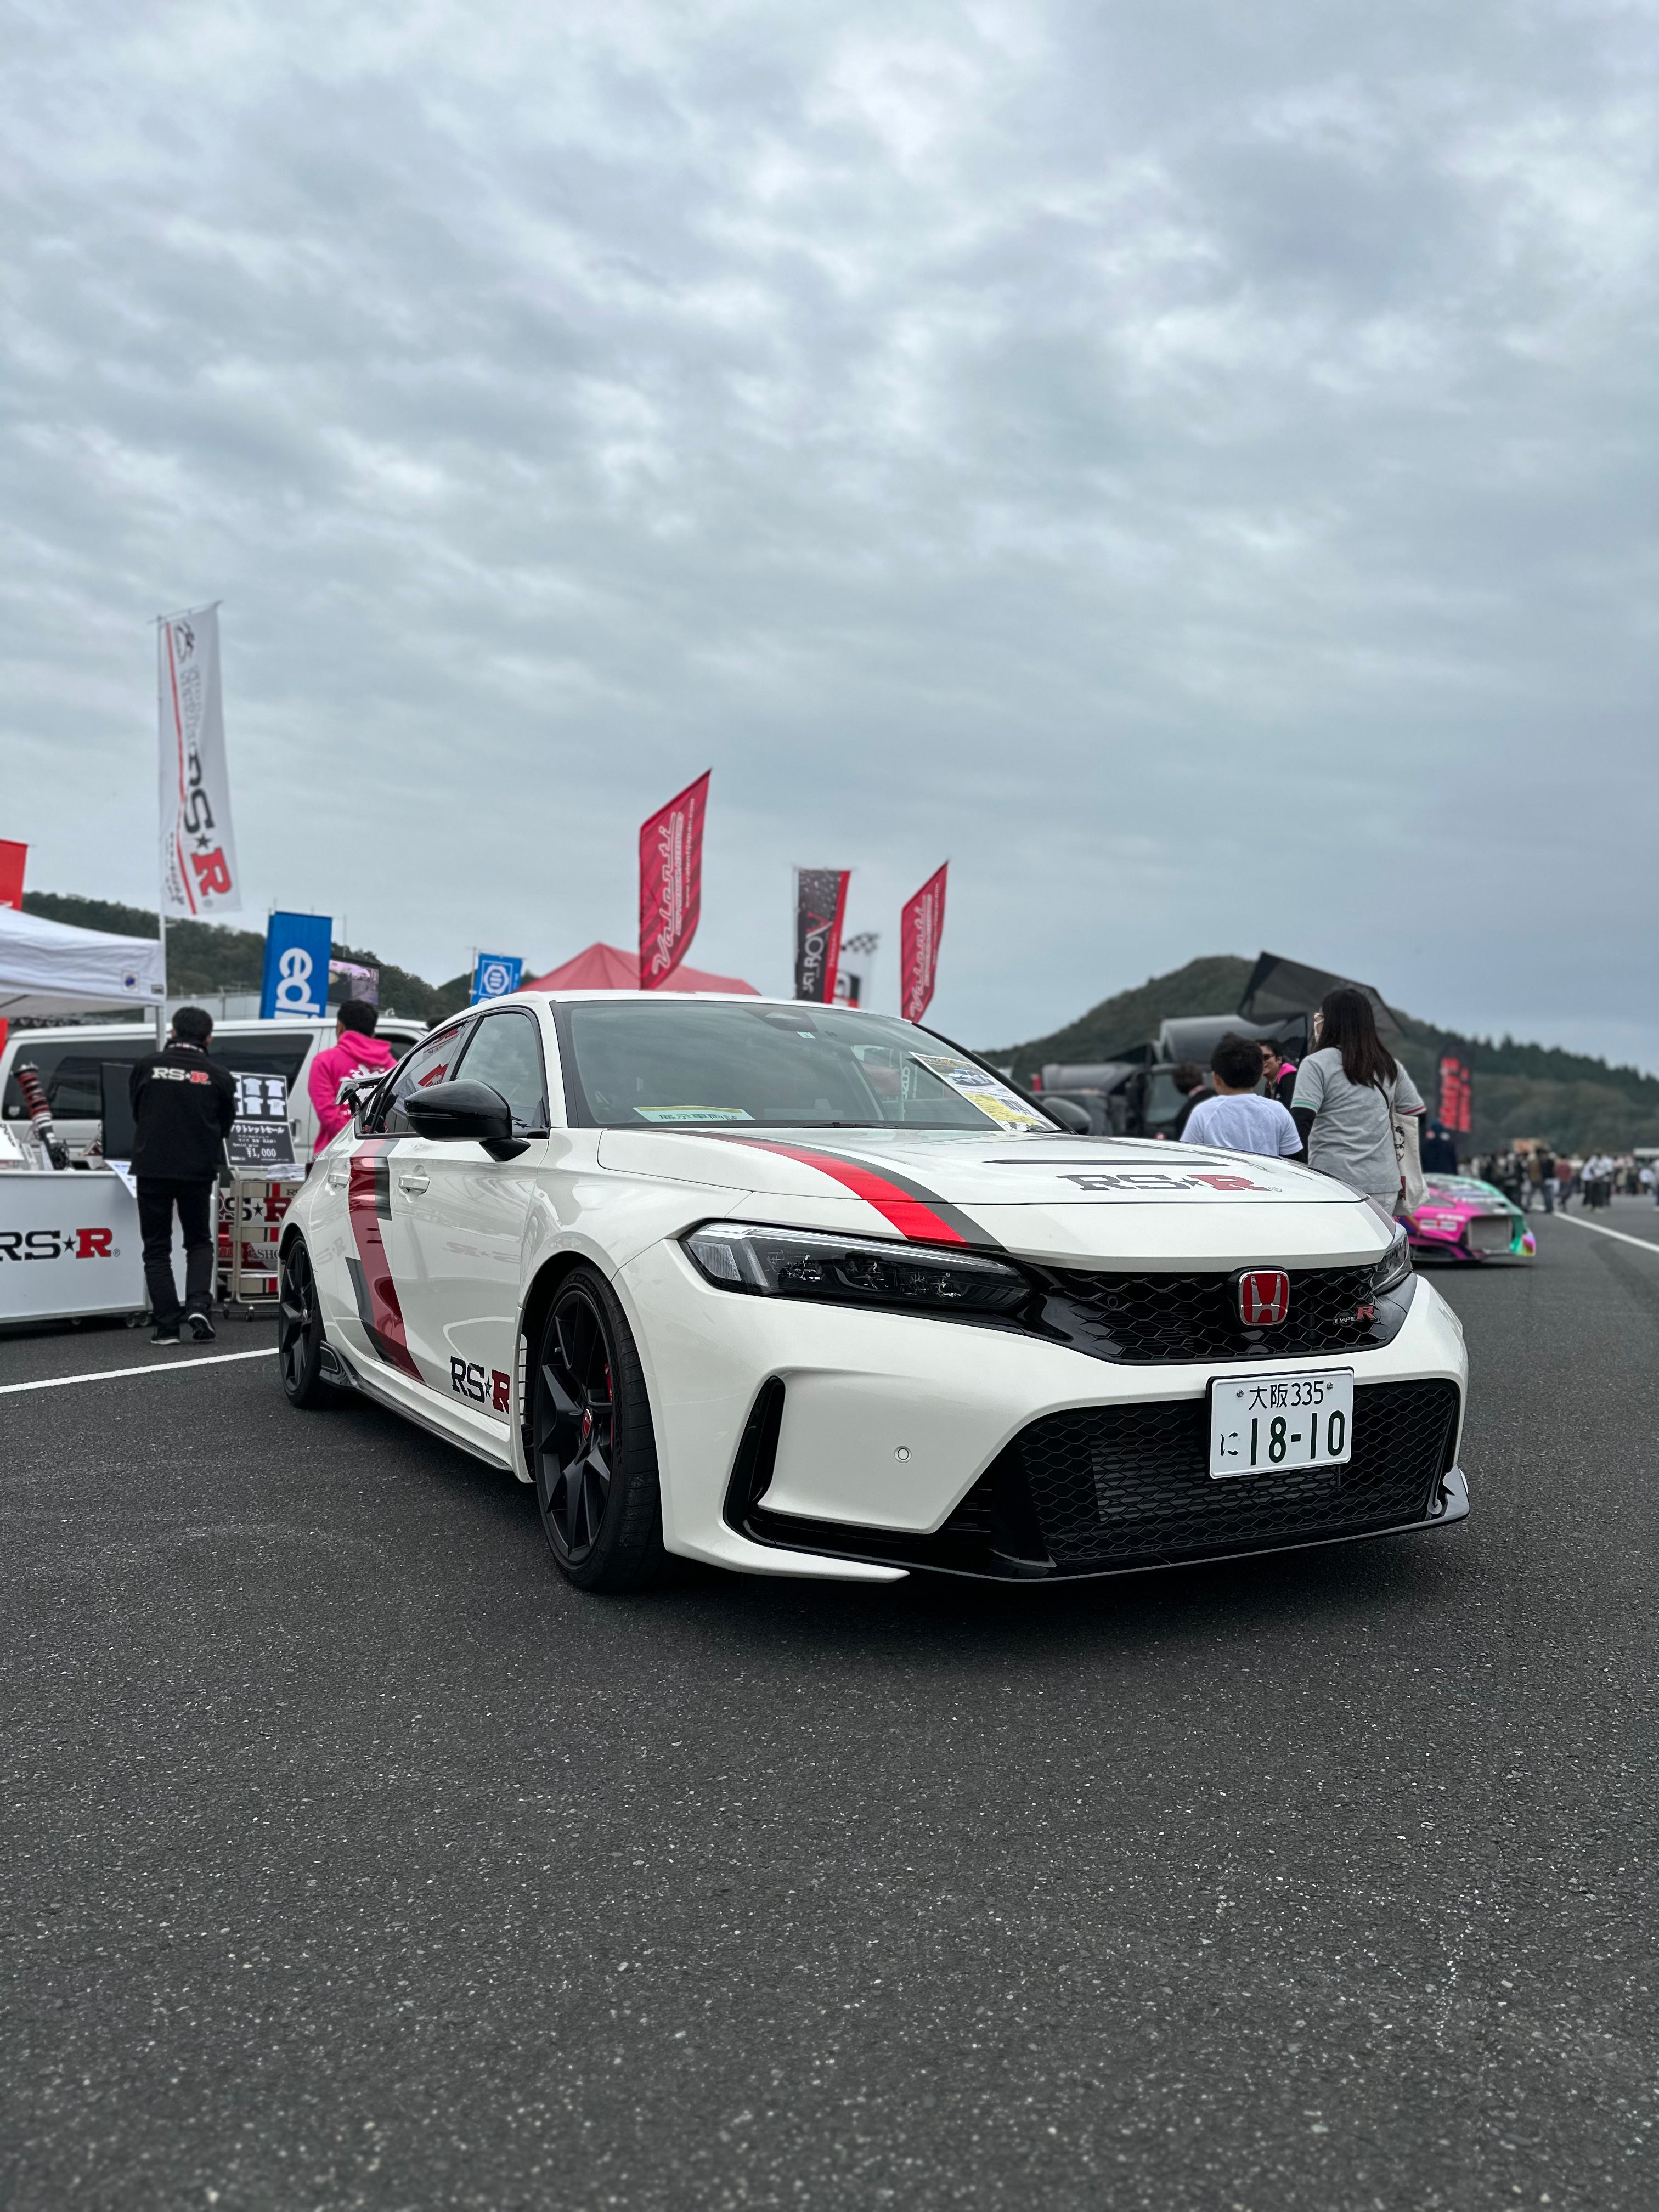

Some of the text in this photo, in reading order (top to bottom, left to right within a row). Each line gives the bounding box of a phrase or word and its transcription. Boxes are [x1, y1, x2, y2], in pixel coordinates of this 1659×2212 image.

[651, 812, 676, 975] Valenti
[910, 895, 926, 1017] Valenti
[246, 1147, 276, 1158] ¥1,000
[1356, 1305, 1377, 1321] R
[1220, 1410, 1345, 1466] に 18-10
